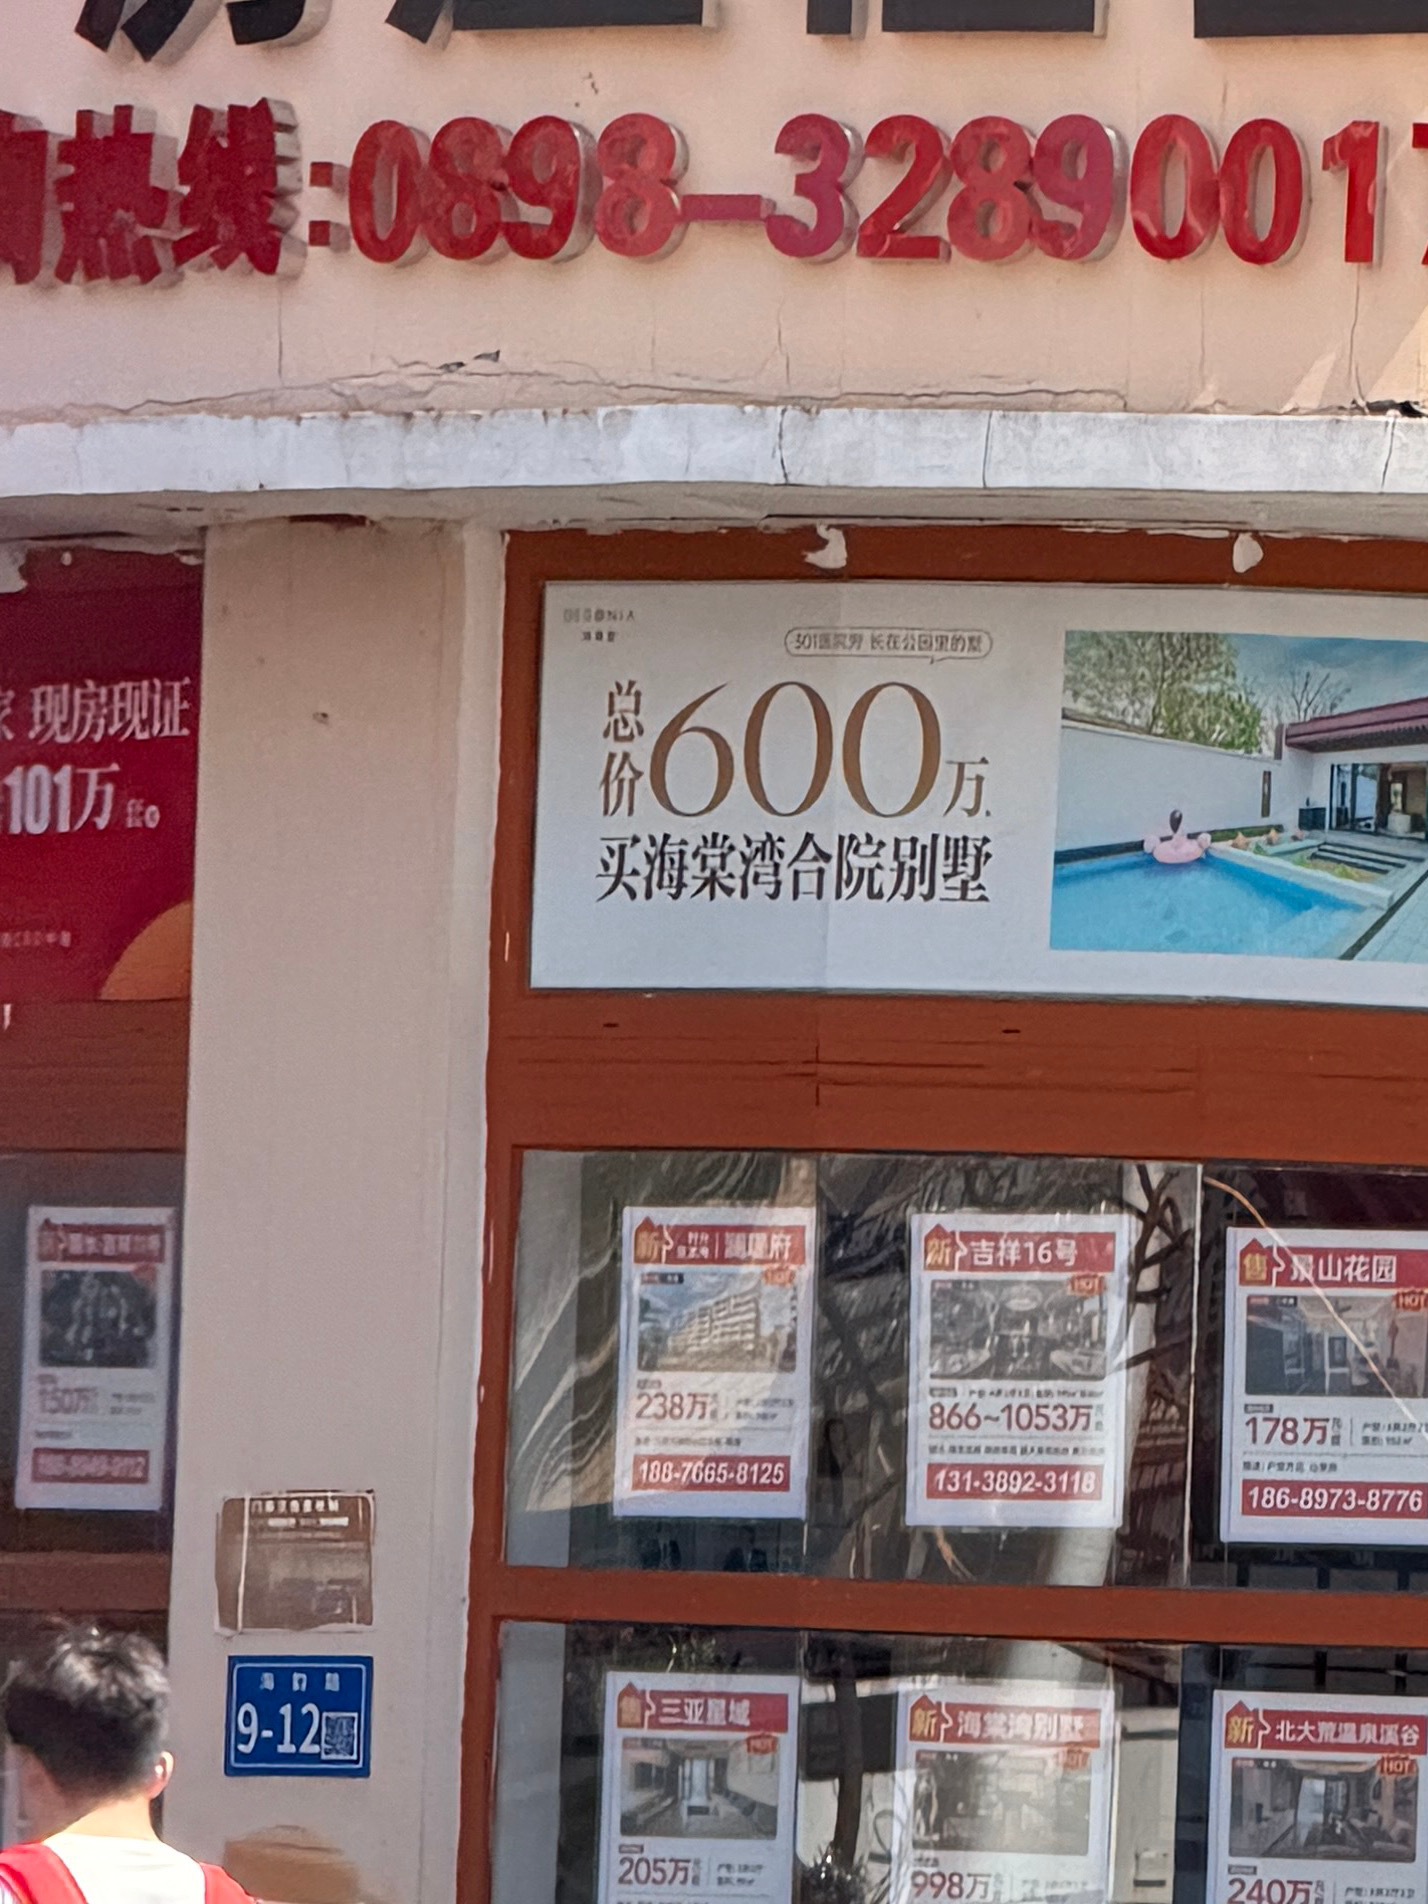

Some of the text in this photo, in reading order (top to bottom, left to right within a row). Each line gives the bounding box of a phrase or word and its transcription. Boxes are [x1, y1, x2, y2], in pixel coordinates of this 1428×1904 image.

[28, 676, 191, 745] 现房现证
[596, 832, 993, 903] 买海棠湾合院别墅
[635, 1392, 711, 1421] 238万
[928, 1401, 1094, 1433] 866~1053万
[1245, 1416, 1330, 1446] 178万
[1248, 1485, 1424, 1513] 186-8973-8776
[237, 1702, 321, 1754] 9-12
[618, 1856, 692, 1886] 205万
[911, 1869, 992, 1900] 998万
